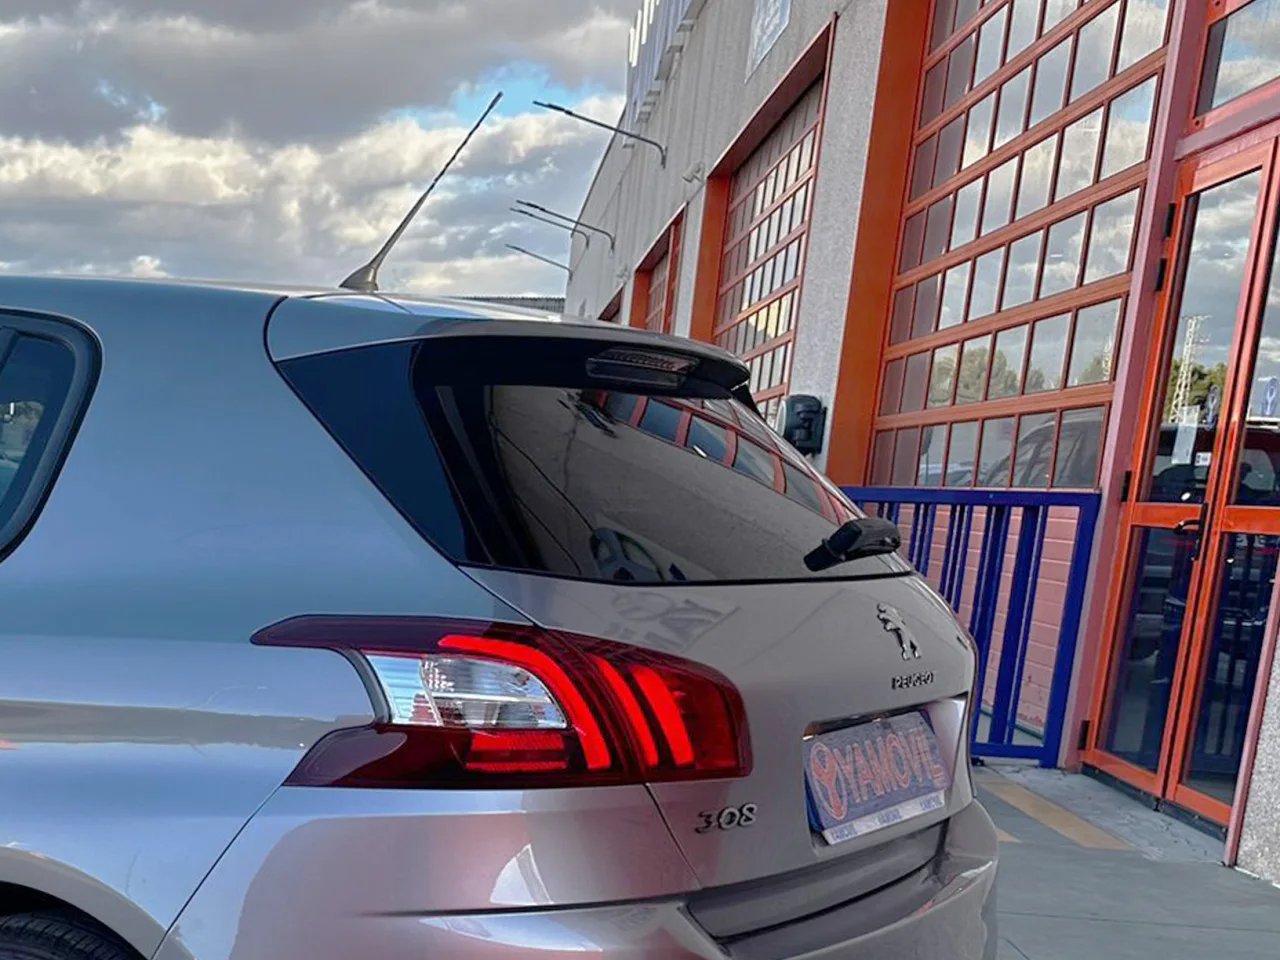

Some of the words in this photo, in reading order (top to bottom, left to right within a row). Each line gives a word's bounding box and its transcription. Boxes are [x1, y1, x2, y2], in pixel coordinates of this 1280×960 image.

[891, 670, 937, 691] PEUGEO
[833, 727, 947, 803] YAMOVIL
[694, 803, 758, 834] 308
